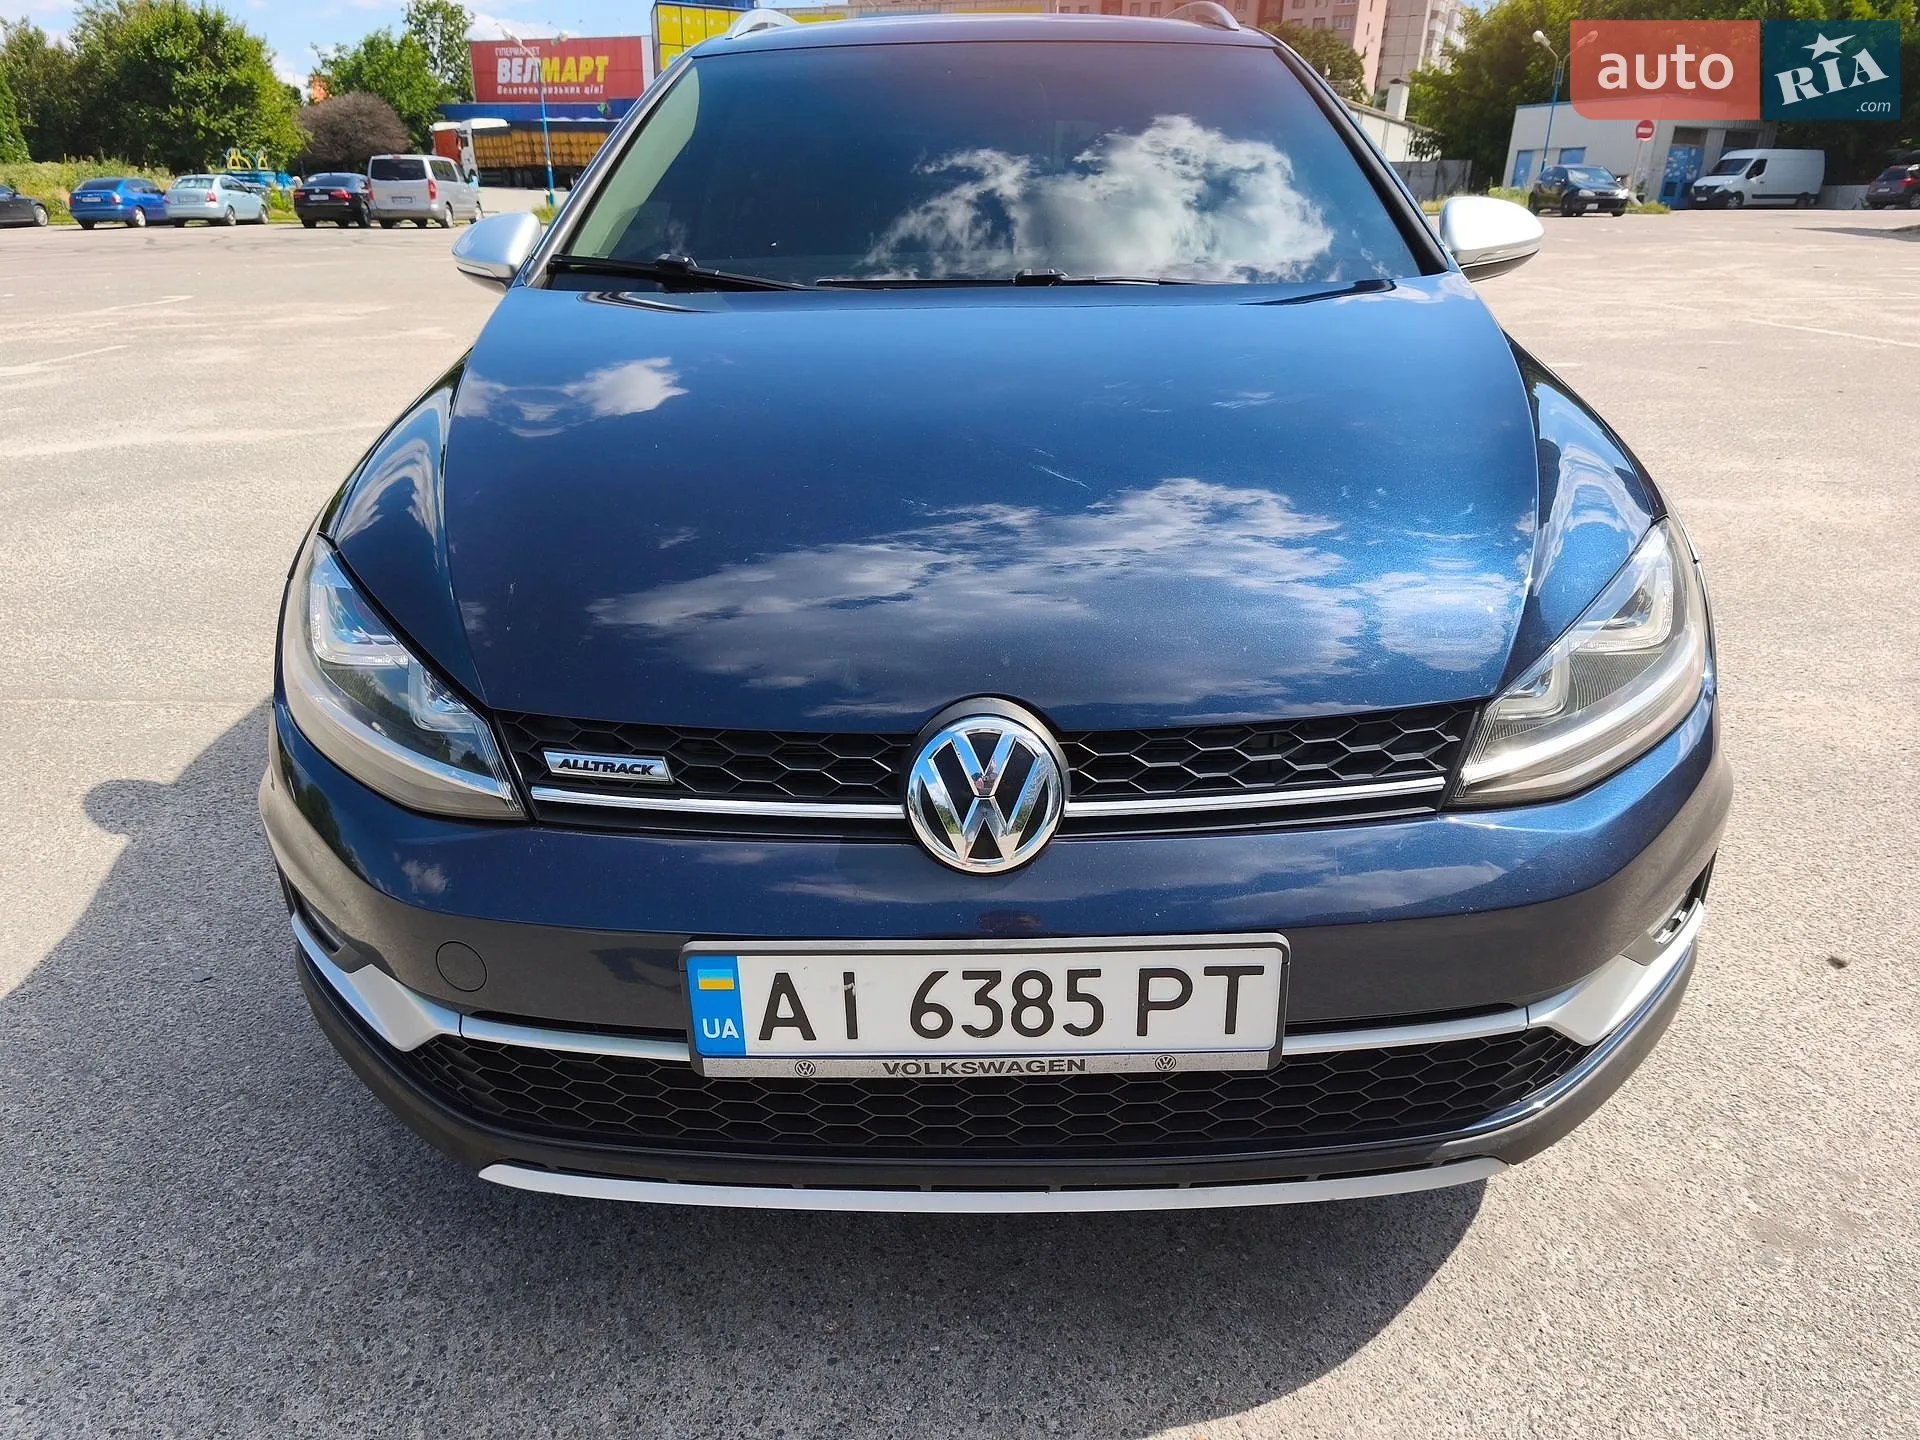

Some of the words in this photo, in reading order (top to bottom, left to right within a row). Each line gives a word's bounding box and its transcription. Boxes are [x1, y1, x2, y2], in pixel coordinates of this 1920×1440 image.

[497, 56, 609, 83] ВЕЛМАРТ
[558, 758, 655, 776] ALLTRACK
[909, 968, 1104, 1039] 6385
[1136, 965, 1265, 1037] PT
[702, 1017, 740, 1039] UA
[881, 1058, 1086, 1076] VOLKSWAGEN
